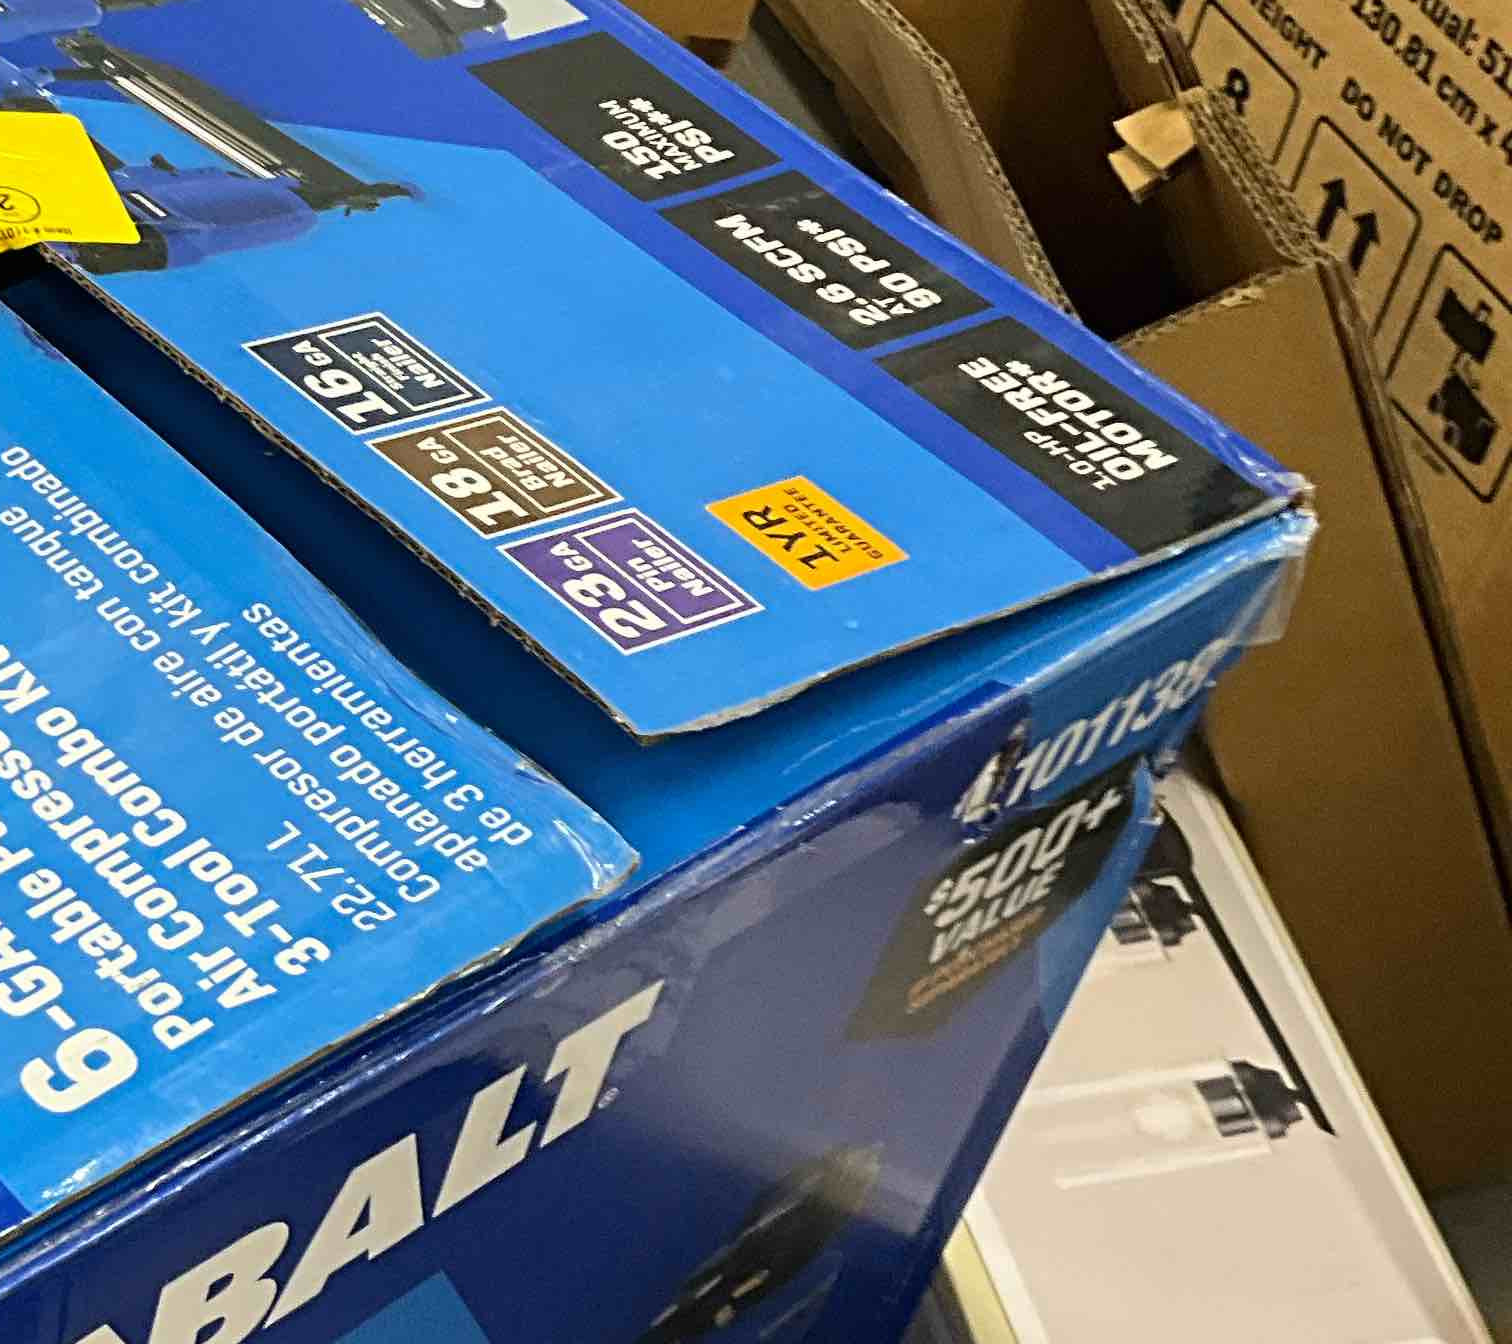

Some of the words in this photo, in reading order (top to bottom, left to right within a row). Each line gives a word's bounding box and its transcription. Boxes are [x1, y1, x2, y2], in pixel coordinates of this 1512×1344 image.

[1435, 74, 1478, 126] cm
[598, 99, 704, 172] MAXIMUM
[600, 129, 682, 181] 150
[1340, 75, 1377, 122] DO
[1376, 113, 1433, 176] NOT
[1433, 170, 1504, 245] DROP
[713, 212, 827, 288] SCFM
[816, 277, 891, 327] 2.6
[879, 270, 943, 313] 90
[882, 297, 910, 318] AT
[291, 339, 333, 371] GA
[370, 337, 446, 389] Nailer
[301, 369, 398, 427] 16
[957, 355, 1147, 483] OIL-FREE
[415, 436, 459, 465] GA
[479, 446, 550, 492] Brad
[496, 433, 578, 489] Nailer
[1023, 429, 1118, 493] 1.0-HP
[0, 444, 161, 585] combinado
[430, 466, 530, 526] 18
[783, 487, 883, 560] GUARANTEE
[548, 540, 592, 574] GA
[783, 504, 851, 554] LIMITED
[630, 536, 714, 599] Nailer
[631, 558, 675, 595] Pin
[94, 594, 162, 652] con
[151, 580, 200, 625] kit
[190, 608, 223, 648] y
[562, 577, 670, 640] 23
[151, 649, 223, 707] aire
[217, 627, 329, 739] portátil
[242, 600, 459, 790] herramientas
[210, 702, 264, 745] de
[39, 704, 189, 850] Combo
[315, 720, 488, 874] aplanado
[444, 781, 483, 812] 3
[252, 736, 441, 906] Compresor
[265, 816, 300, 852] L
[482, 805, 534, 848] de
[287, 839, 397, 932] 22.71
[922, 788, 1128, 931] $500+
[179, 827, 332, 977] 3-Tool
[928, 860, 1064, 965] VALUE
[19, 852, 215, 1051] Portable
[187, 941, 278, 1009] Air
